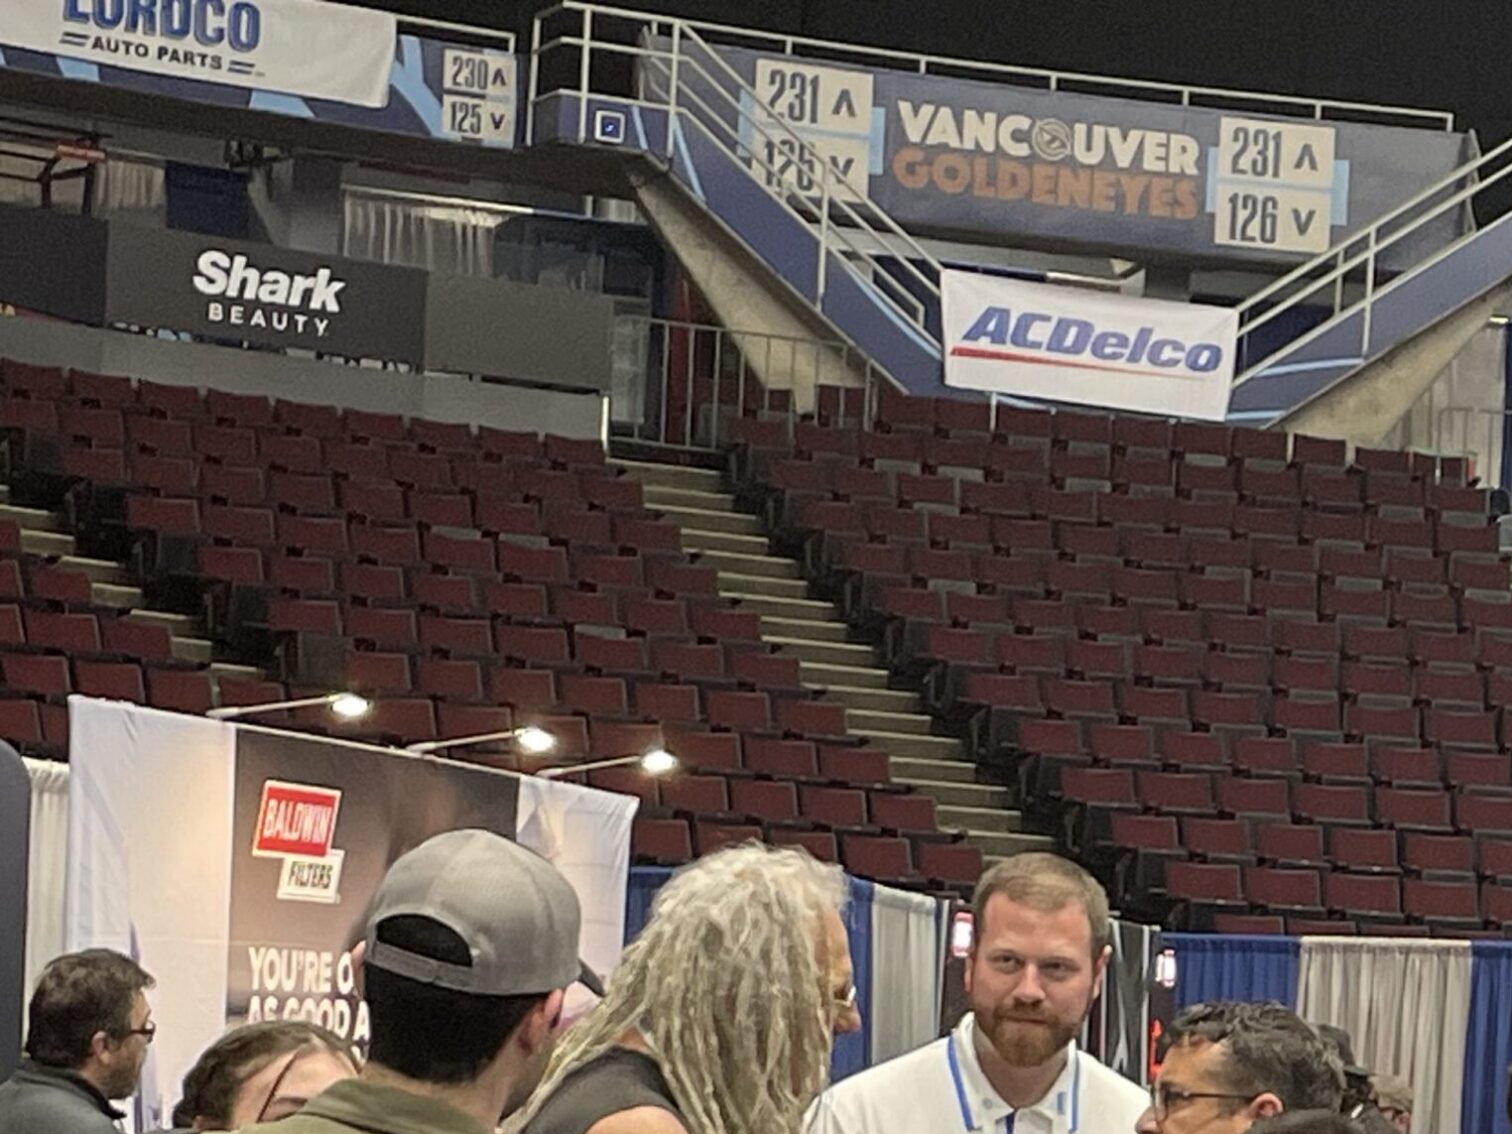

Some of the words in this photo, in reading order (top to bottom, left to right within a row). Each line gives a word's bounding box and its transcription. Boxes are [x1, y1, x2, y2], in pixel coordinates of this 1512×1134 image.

[91, 36, 149, 58] AUTO
[157, 46, 223, 71] PARTS
[452, 56, 488, 90] 230
[451, 101, 482, 134] 125
[768, 69, 820, 124] 231
[897, 99, 1200, 176] VANCOUVER
[1231, 126, 1282, 178] 231
[892, 146, 1198, 220] GOLDENEYES
[1228, 192, 1278, 244] 126
[193, 250, 346, 313] Shark
[208, 302, 328, 337] BEAUTY
[962, 305, 1222, 373] ACDelco
[262, 798, 333, 845] BALDWIN
[287, 860, 334, 889] FILTERS
[248, 946, 333, 993] YOU'RE
